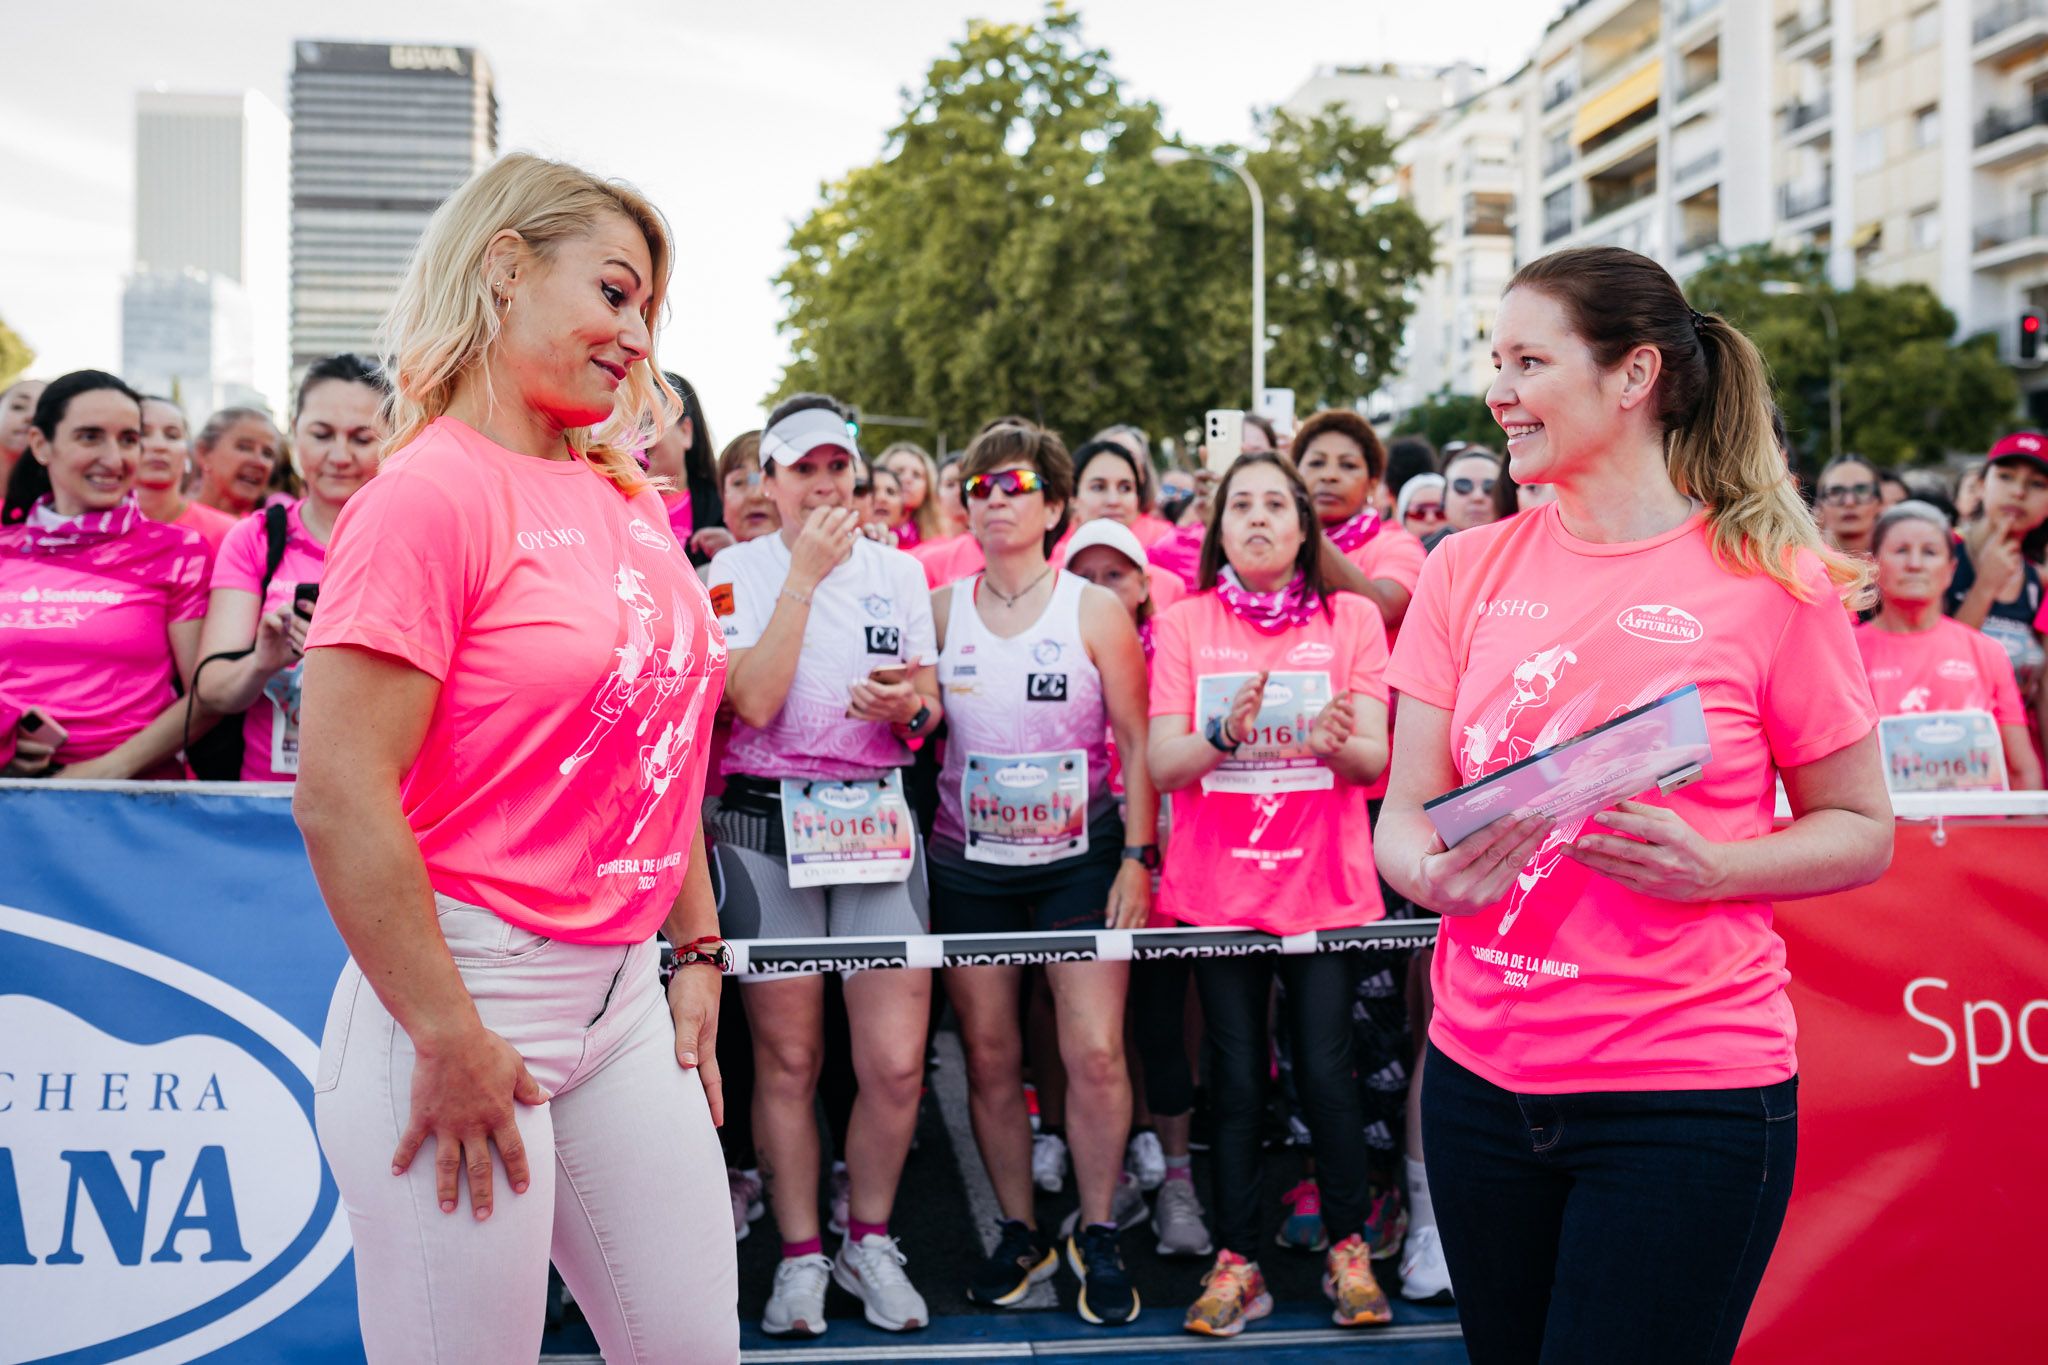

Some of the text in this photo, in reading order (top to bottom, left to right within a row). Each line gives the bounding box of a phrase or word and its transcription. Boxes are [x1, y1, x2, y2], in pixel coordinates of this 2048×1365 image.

[389, 46, 463, 73] BBVA
[517, 528, 585, 550] OYSHO
[41, 588, 124, 604] Santander
[1622, 612, 1696, 638] ASTURIANA
[1243, 726, 1292, 745] 016
[1925, 759, 1968, 777] 016
[1001, 803, 1048, 822] 016
[829, 817, 876, 837] 016
[597, 859, 640, 877] CARRERA
[642, 859, 656, 873] DE
[638, 876, 658, 890] 2024
[1471, 945, 1579, 979] CARRERA DE LA MUJER
[1503, 970, 1529, 988] 2024
